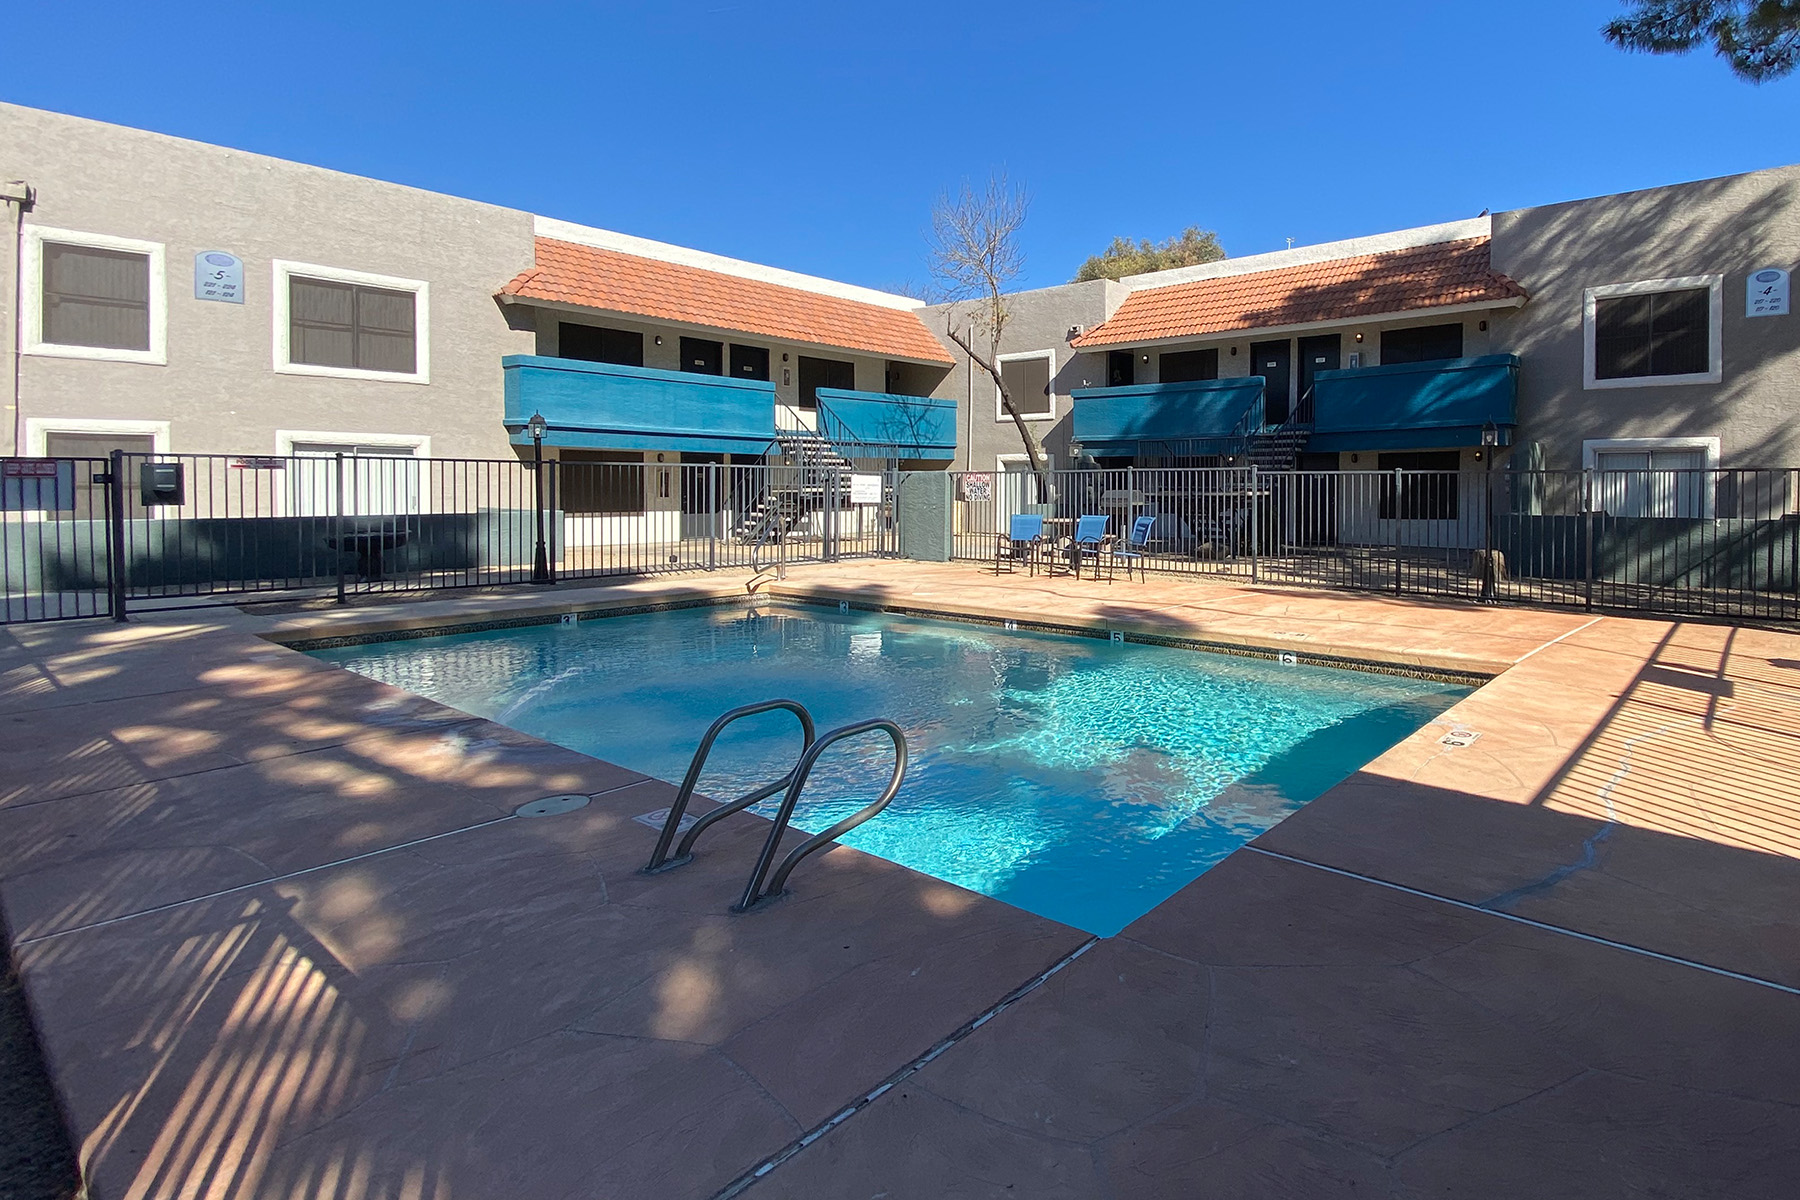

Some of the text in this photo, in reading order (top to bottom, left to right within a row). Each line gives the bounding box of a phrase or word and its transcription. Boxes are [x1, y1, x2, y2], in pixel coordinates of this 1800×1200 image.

[965, 473, 991, 482] CAUTION
[966, 481, 990, 489] SHALLOW
[841, 601, 847, 614] 3
[1114, 632, 1121, 645] 5
[1283, 652, 1293, 664] 6
